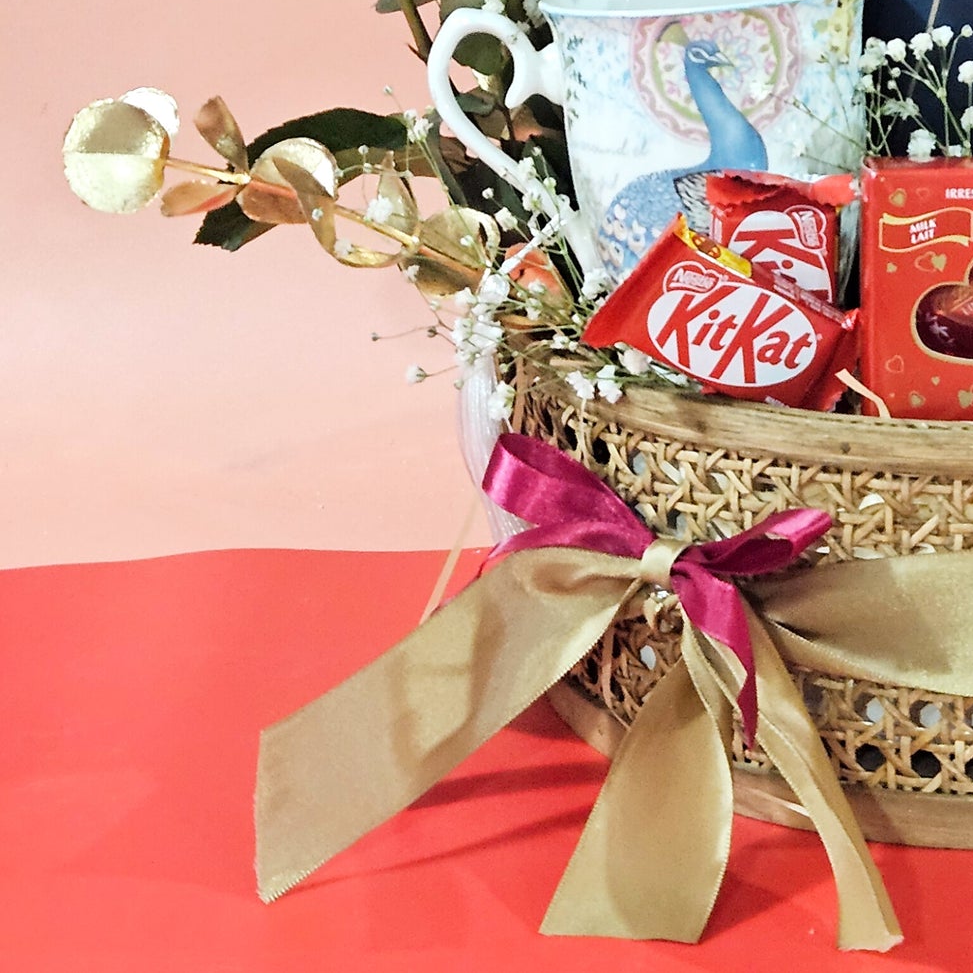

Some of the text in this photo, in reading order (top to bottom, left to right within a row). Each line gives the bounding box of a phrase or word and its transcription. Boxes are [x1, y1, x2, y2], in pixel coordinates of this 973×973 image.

[909, 218, 937, 234] MILK
[910, 229, 935, 244] LAIT
[656, 284, 813, 384] KitKat
